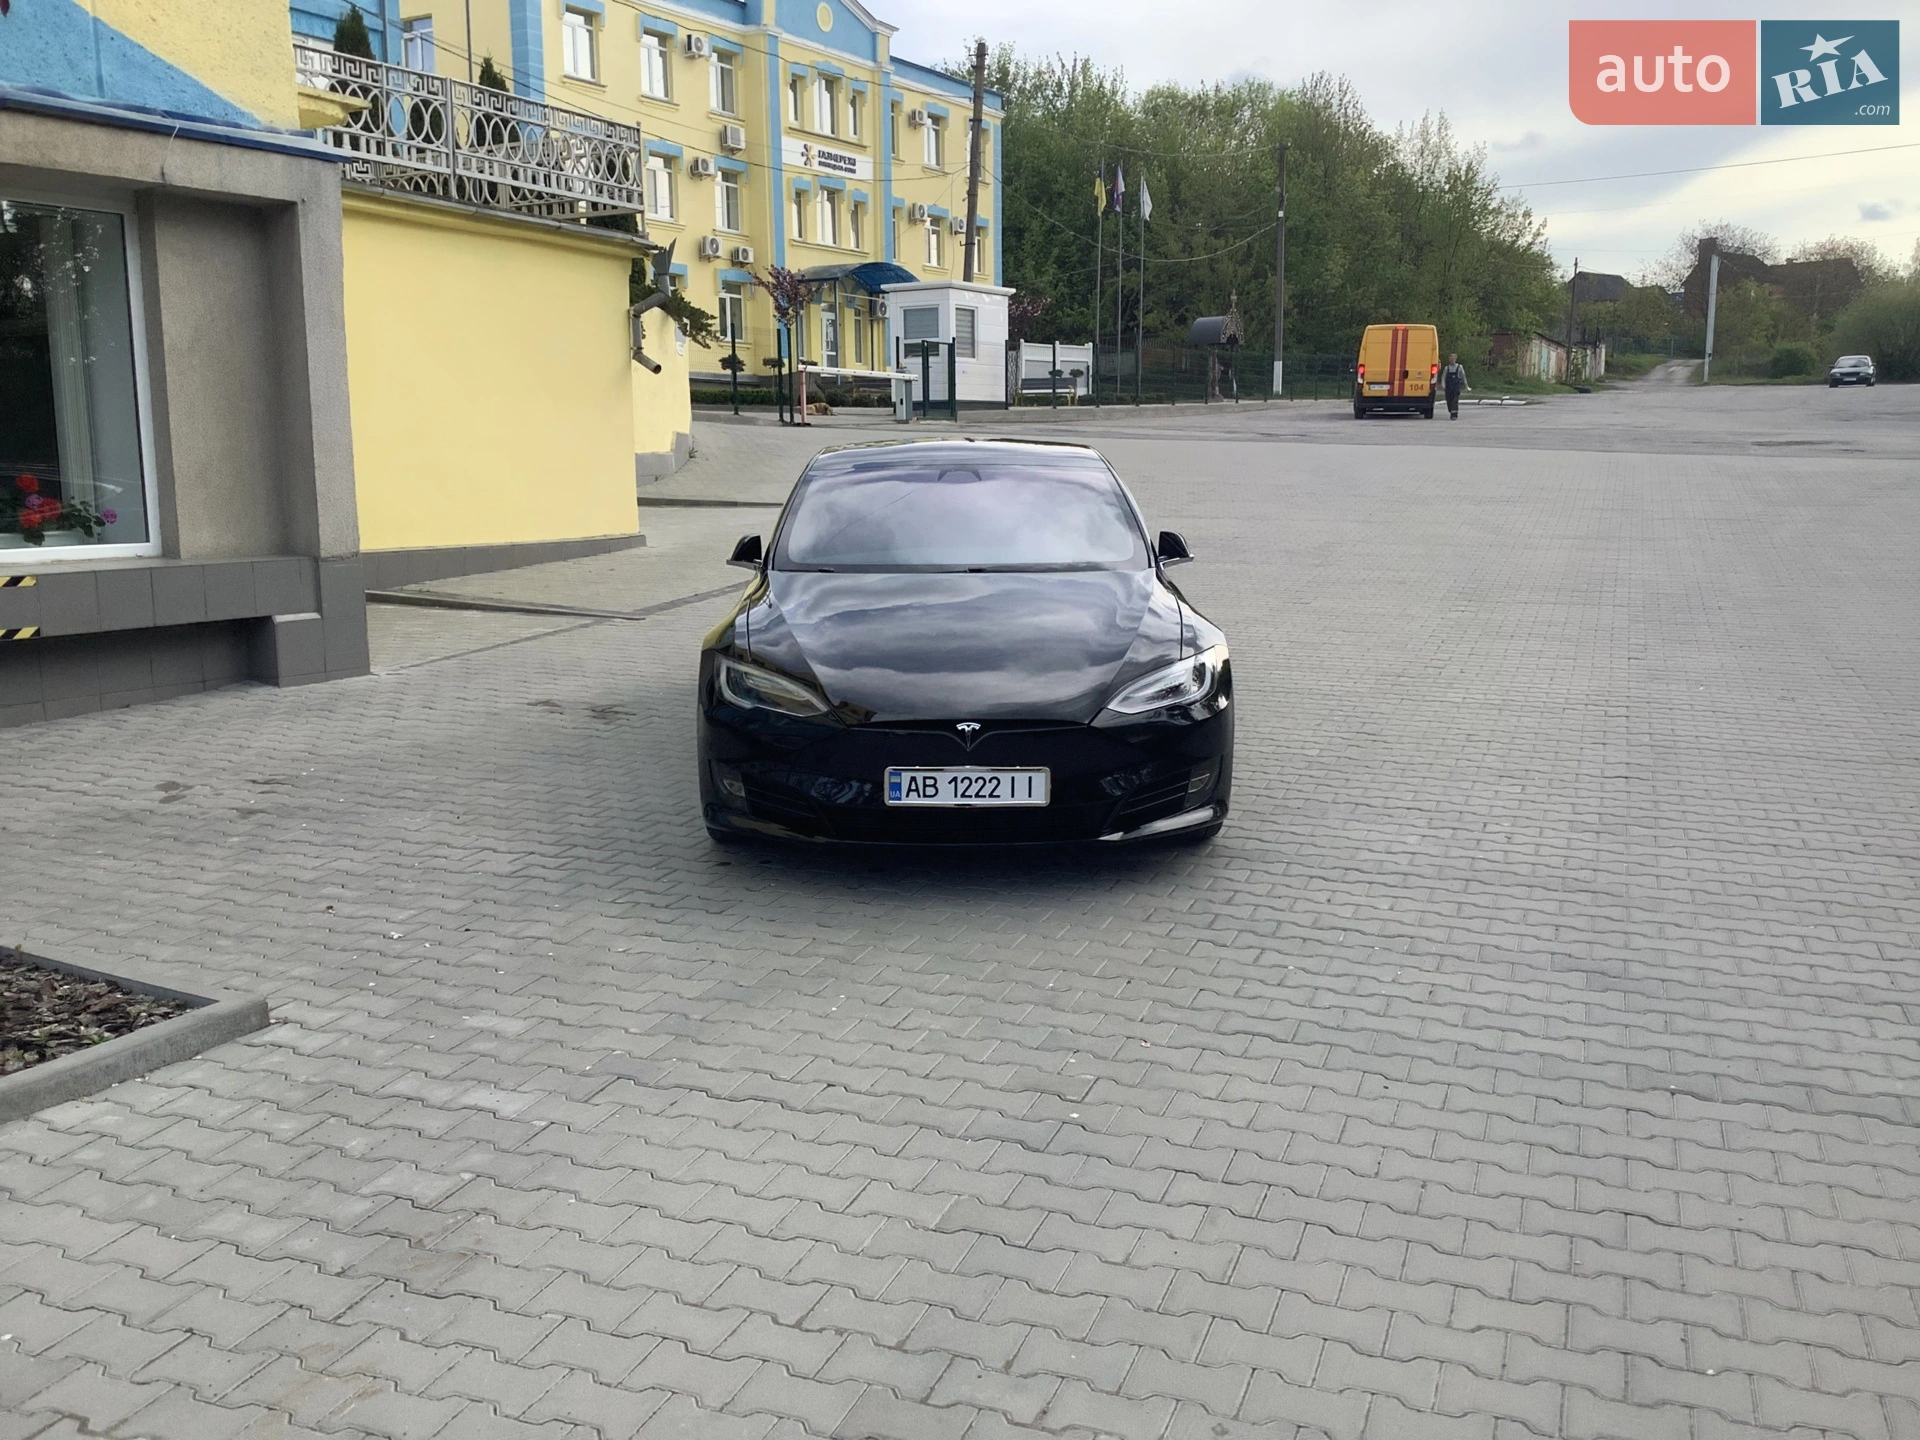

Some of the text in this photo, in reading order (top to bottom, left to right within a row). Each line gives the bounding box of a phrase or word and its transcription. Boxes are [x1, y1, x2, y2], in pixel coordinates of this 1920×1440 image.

[1409, 383, 1424, 392] 104
[905, 775, 939, 799] AB
[948, 775, 1001, 799] 1222
[889, 790, 901, 798] UA
